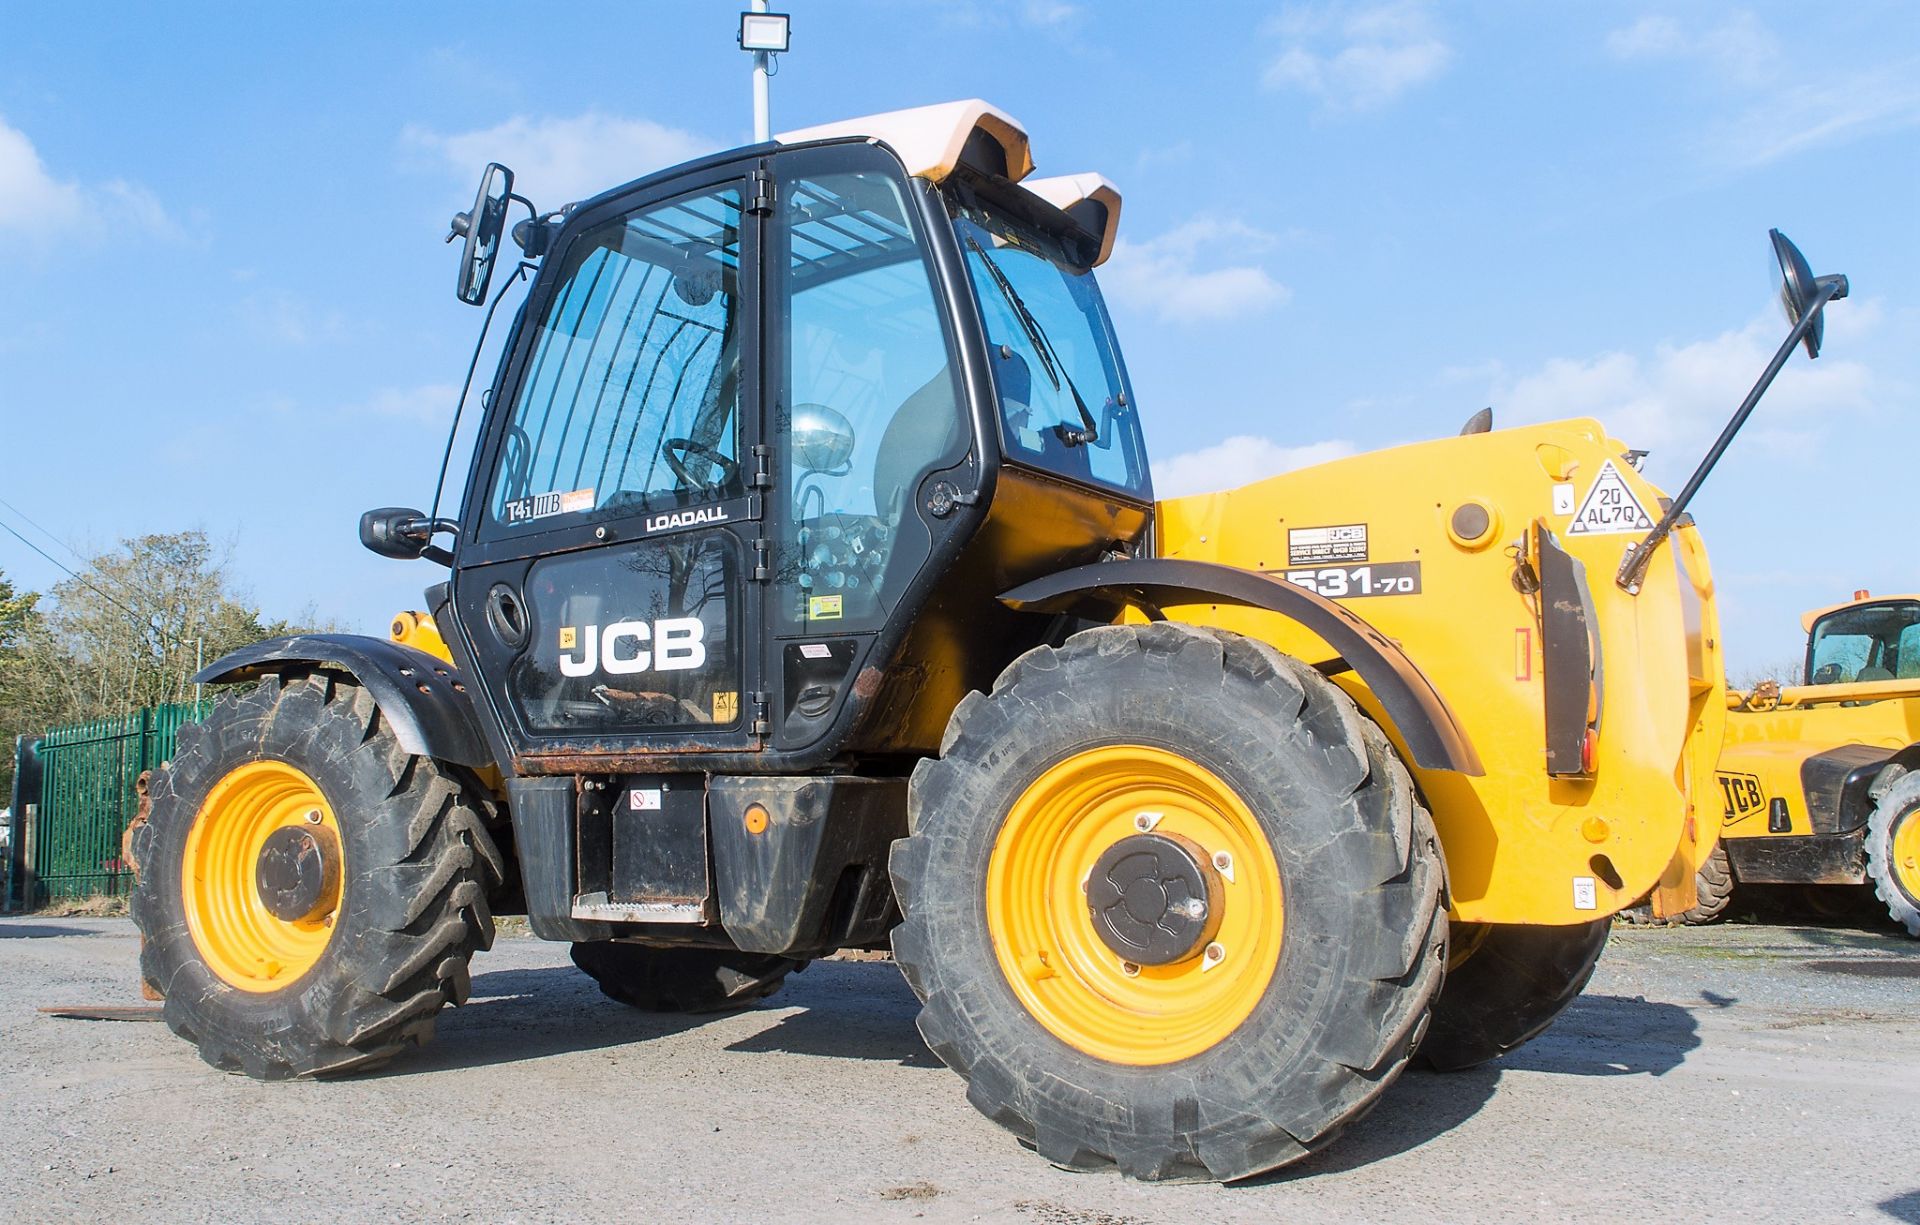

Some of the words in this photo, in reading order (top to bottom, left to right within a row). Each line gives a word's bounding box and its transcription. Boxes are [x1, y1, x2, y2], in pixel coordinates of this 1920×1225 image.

[507, 500, 532, 521] T4i
[646, 506, 728, 532] LOADALL
[1287, 567, 1414, 597] 531-70
[560, 617, 706, 678] JCB
[1718, 777, 1760, 819] JCB
